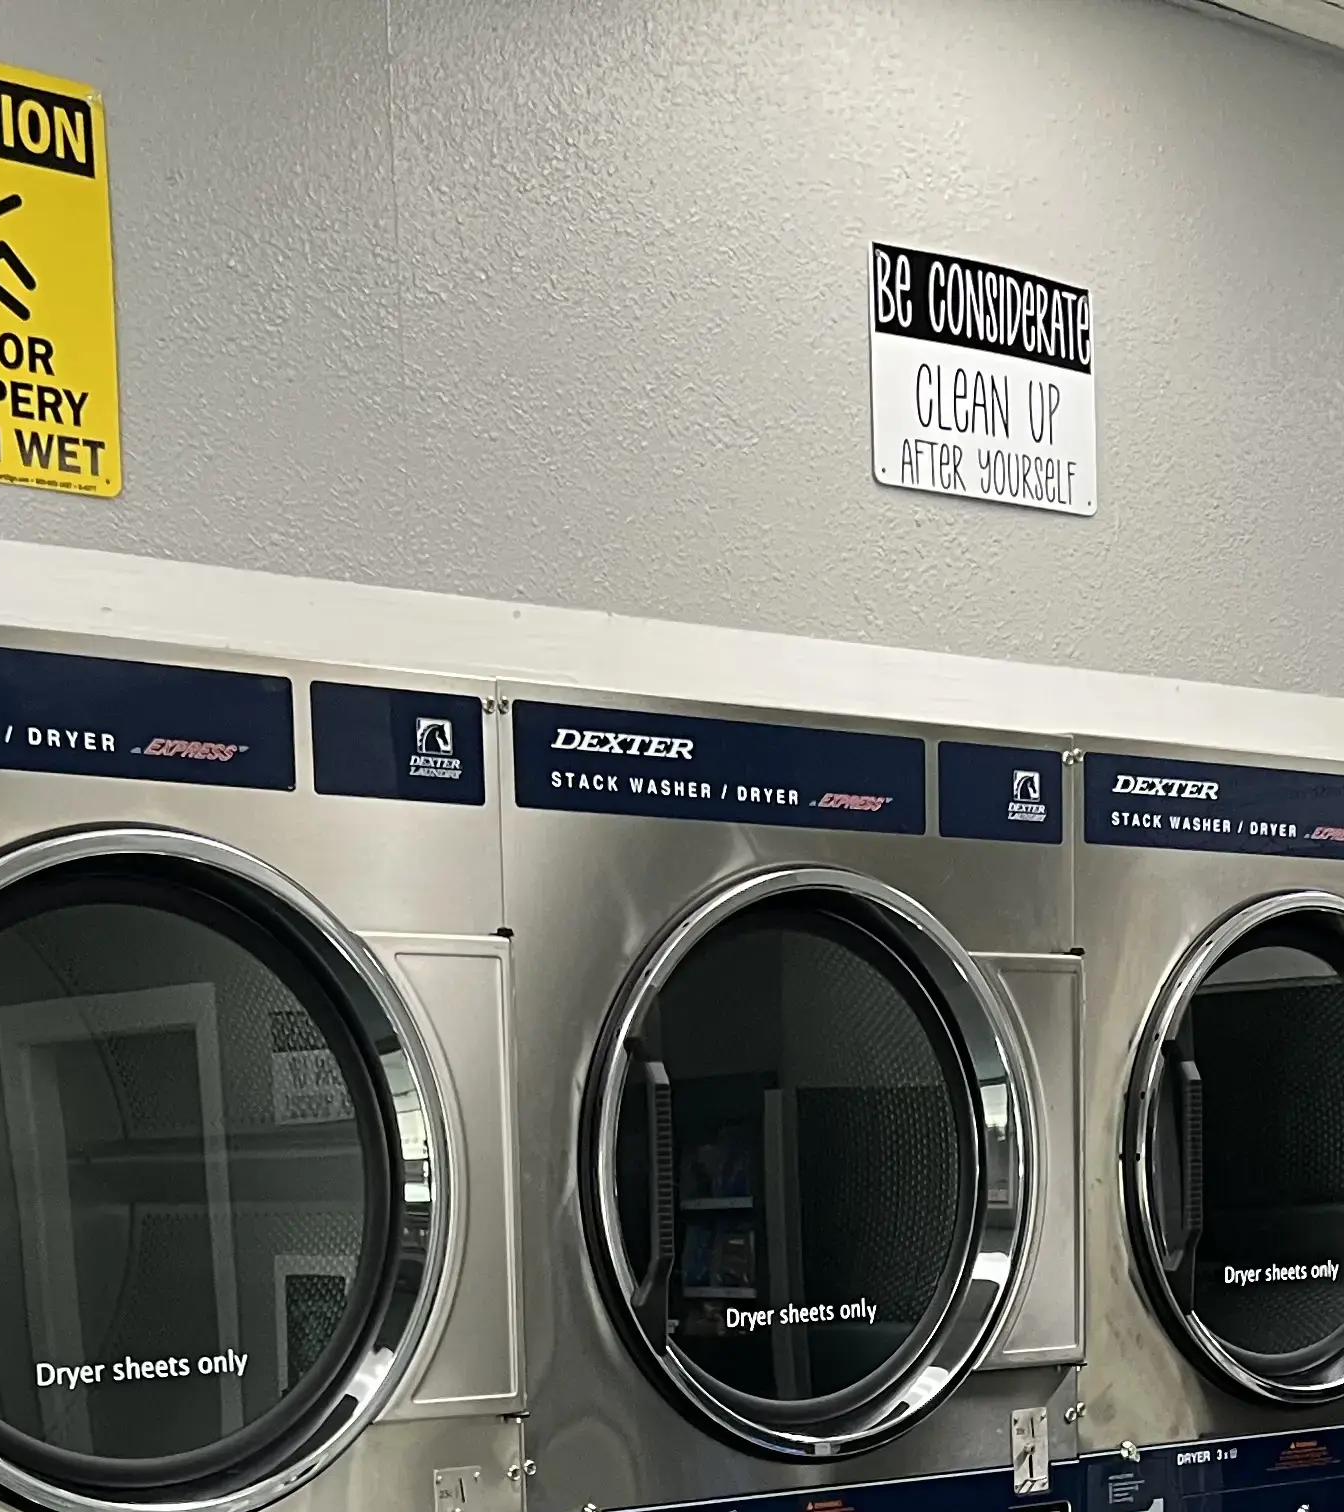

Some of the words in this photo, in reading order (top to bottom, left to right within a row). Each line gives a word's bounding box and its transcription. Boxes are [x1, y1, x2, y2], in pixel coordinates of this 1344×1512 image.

[1028, 379, 1060, 446] UP
[15, 429, 105, 477] WET
[4, 725, 15, 744] /
[27, 726, 117, 753] DRYER
[143, 736, 240, 763] EXPRESS
[551, 728, 695, 760] DEXTER
[409, 755, 462, 769] DEXTER
[551, 771, 619, 792] STACK
[629, 777, 713, 799] WASHER
[720, 784, 727, 801] /
[737, 786, 800, 806] DRYER
[1112, 774, 1219, 800] DEXTER
[1007, 802, 1047, 814] DEXTER
[1111, 811, 1162, 829] STACK
[1169, 816, 1231, 834] WASHER
[1249, 821, 1297, 838] DRYER
[1224, 1265, 1262, 1287] Dryer
[1265, 1263, 1307, 1281] sheets
[1310, 1259, 1340, 1281] only
[726, 1307, 775, 1332] Dryer
[779, 1303, 835, 1325] sheets
[839, 1297, 877, 1325] only
[36, 1362, 105, 1390] Dryer
[112, 1356, 189, 1381] sheets
[198, 1348, 248, 1377] only
[1176, 1450, 1211, 1466] DRYER
[1216, 1449, 1223, 1461] 3
